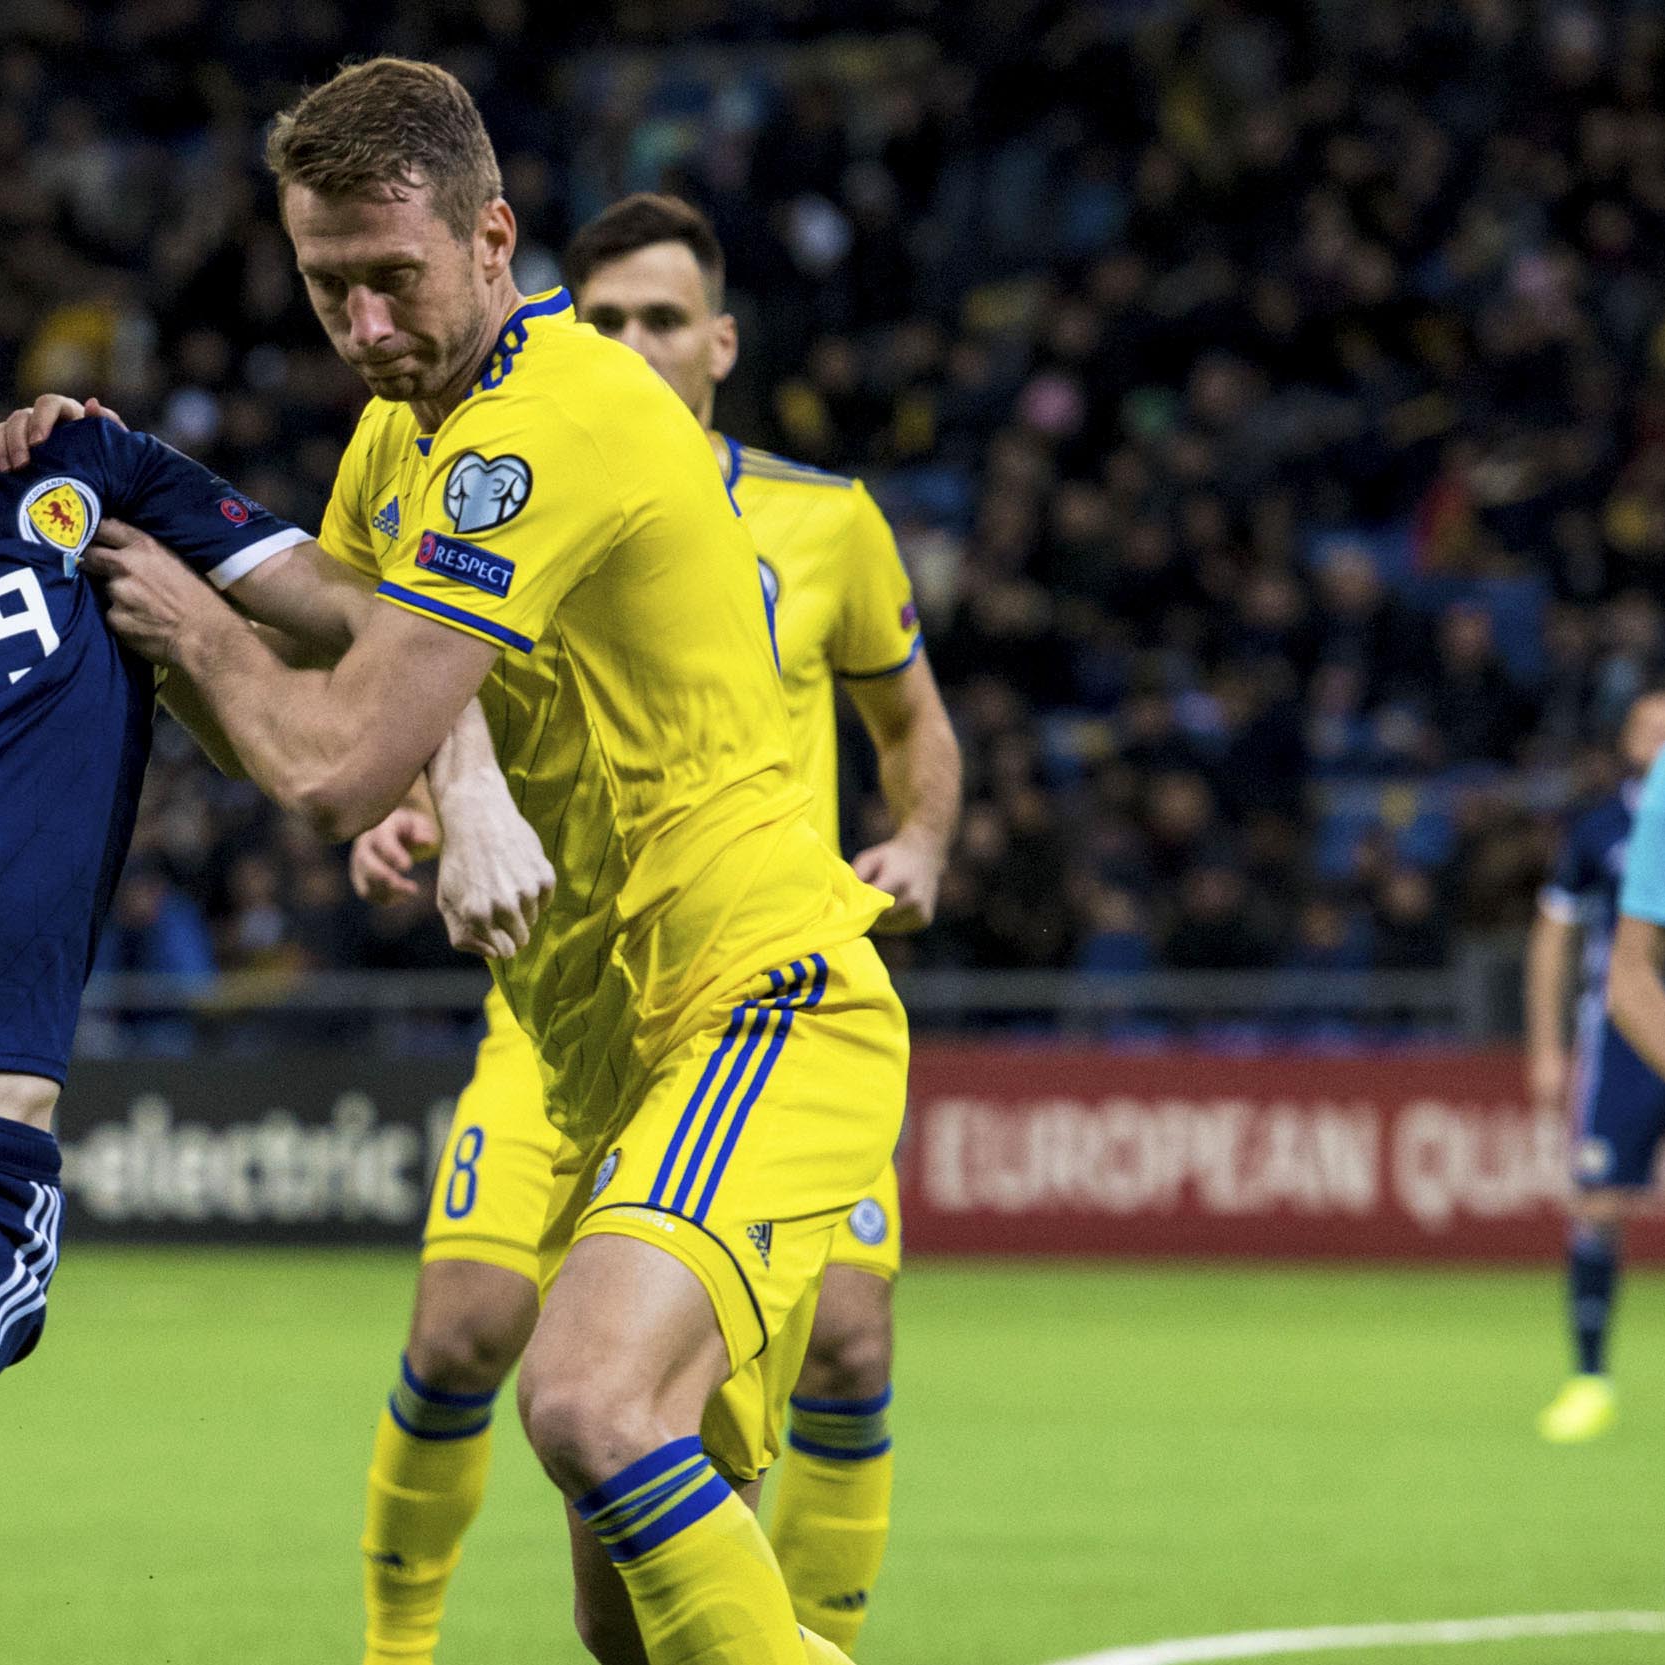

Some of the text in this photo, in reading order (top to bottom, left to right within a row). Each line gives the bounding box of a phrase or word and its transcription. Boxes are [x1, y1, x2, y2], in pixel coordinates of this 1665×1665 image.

[435, 545, 512, 588] RESPECT
[445, 1126, 484, 1219] 8
[927, 1098, 1382, 1209] EUROPEAN
